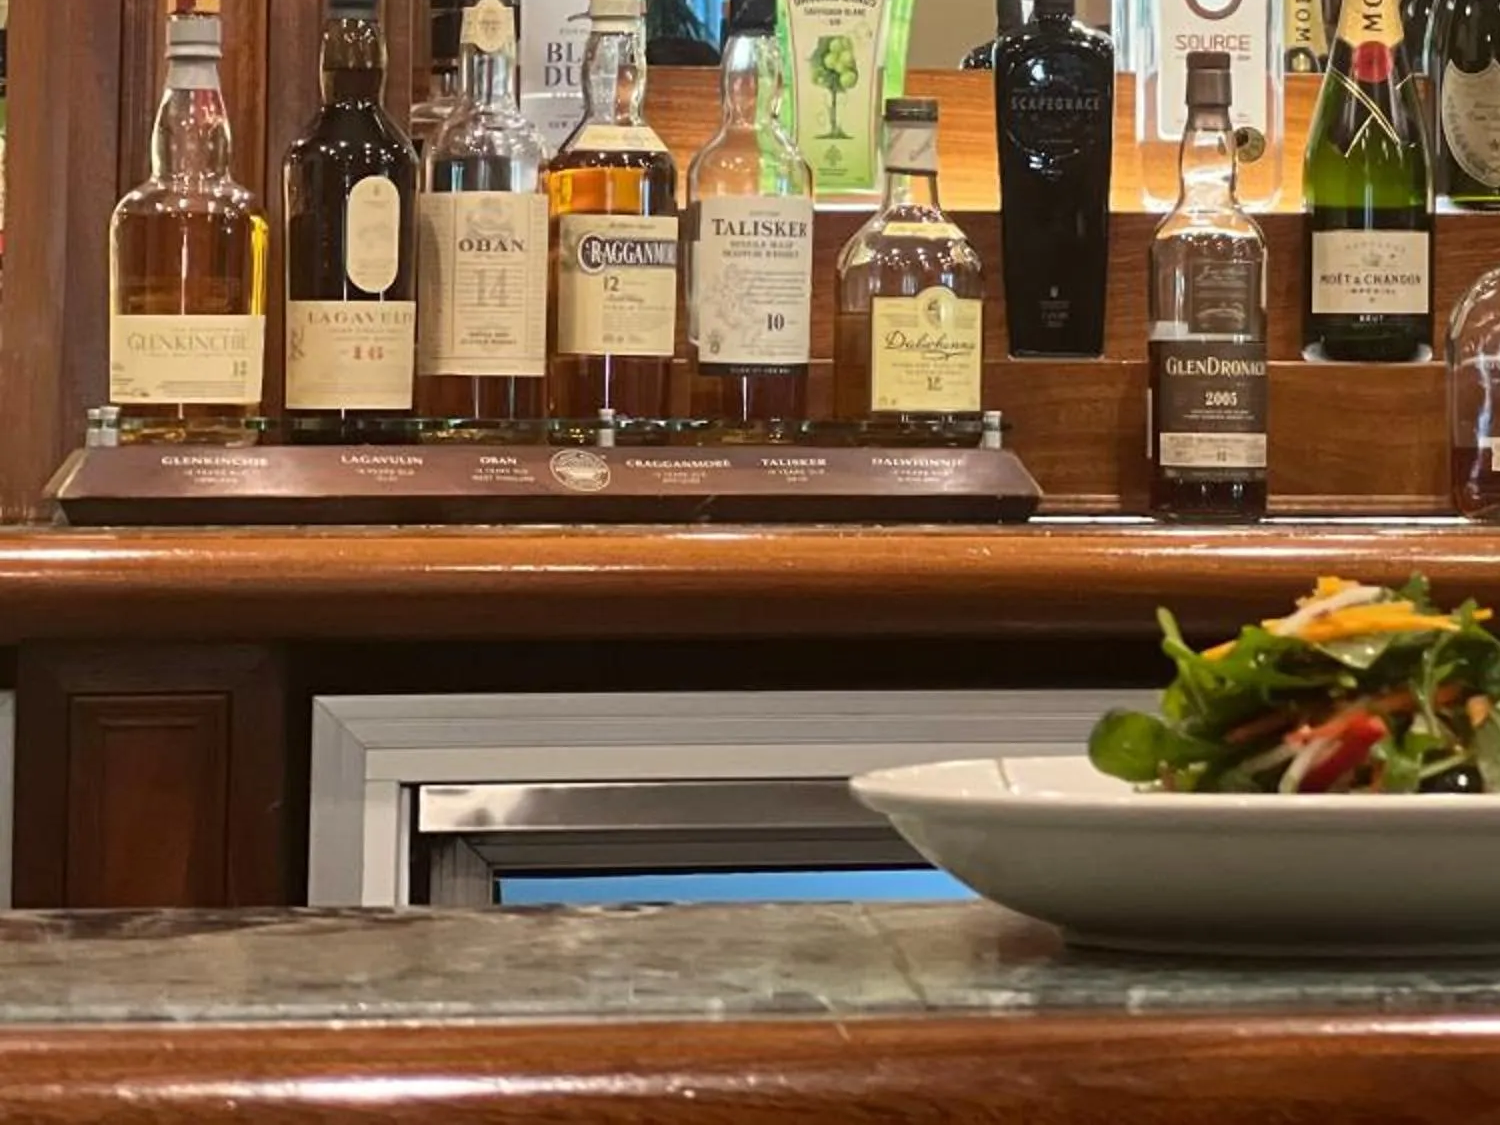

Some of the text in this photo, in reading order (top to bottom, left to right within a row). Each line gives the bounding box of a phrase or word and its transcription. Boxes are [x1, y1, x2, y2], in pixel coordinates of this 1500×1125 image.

[1174, 34, 1251, 51] SOURCE
[1011, 97, 1100, 110] SCAPEGRACE
[711, 218, 808, 239] TALISKER
[458, 238, 526, 253] OBAN
[603, 276, 620, 292] 12
[766, 312, 785, 331] 10
[353, 346, 384, 361] 16
[340, 454, 424, 466] LAGAVULIN
[479, 456, 517, 466] OBAN
[760, 458, 828, 467] TALISKER
